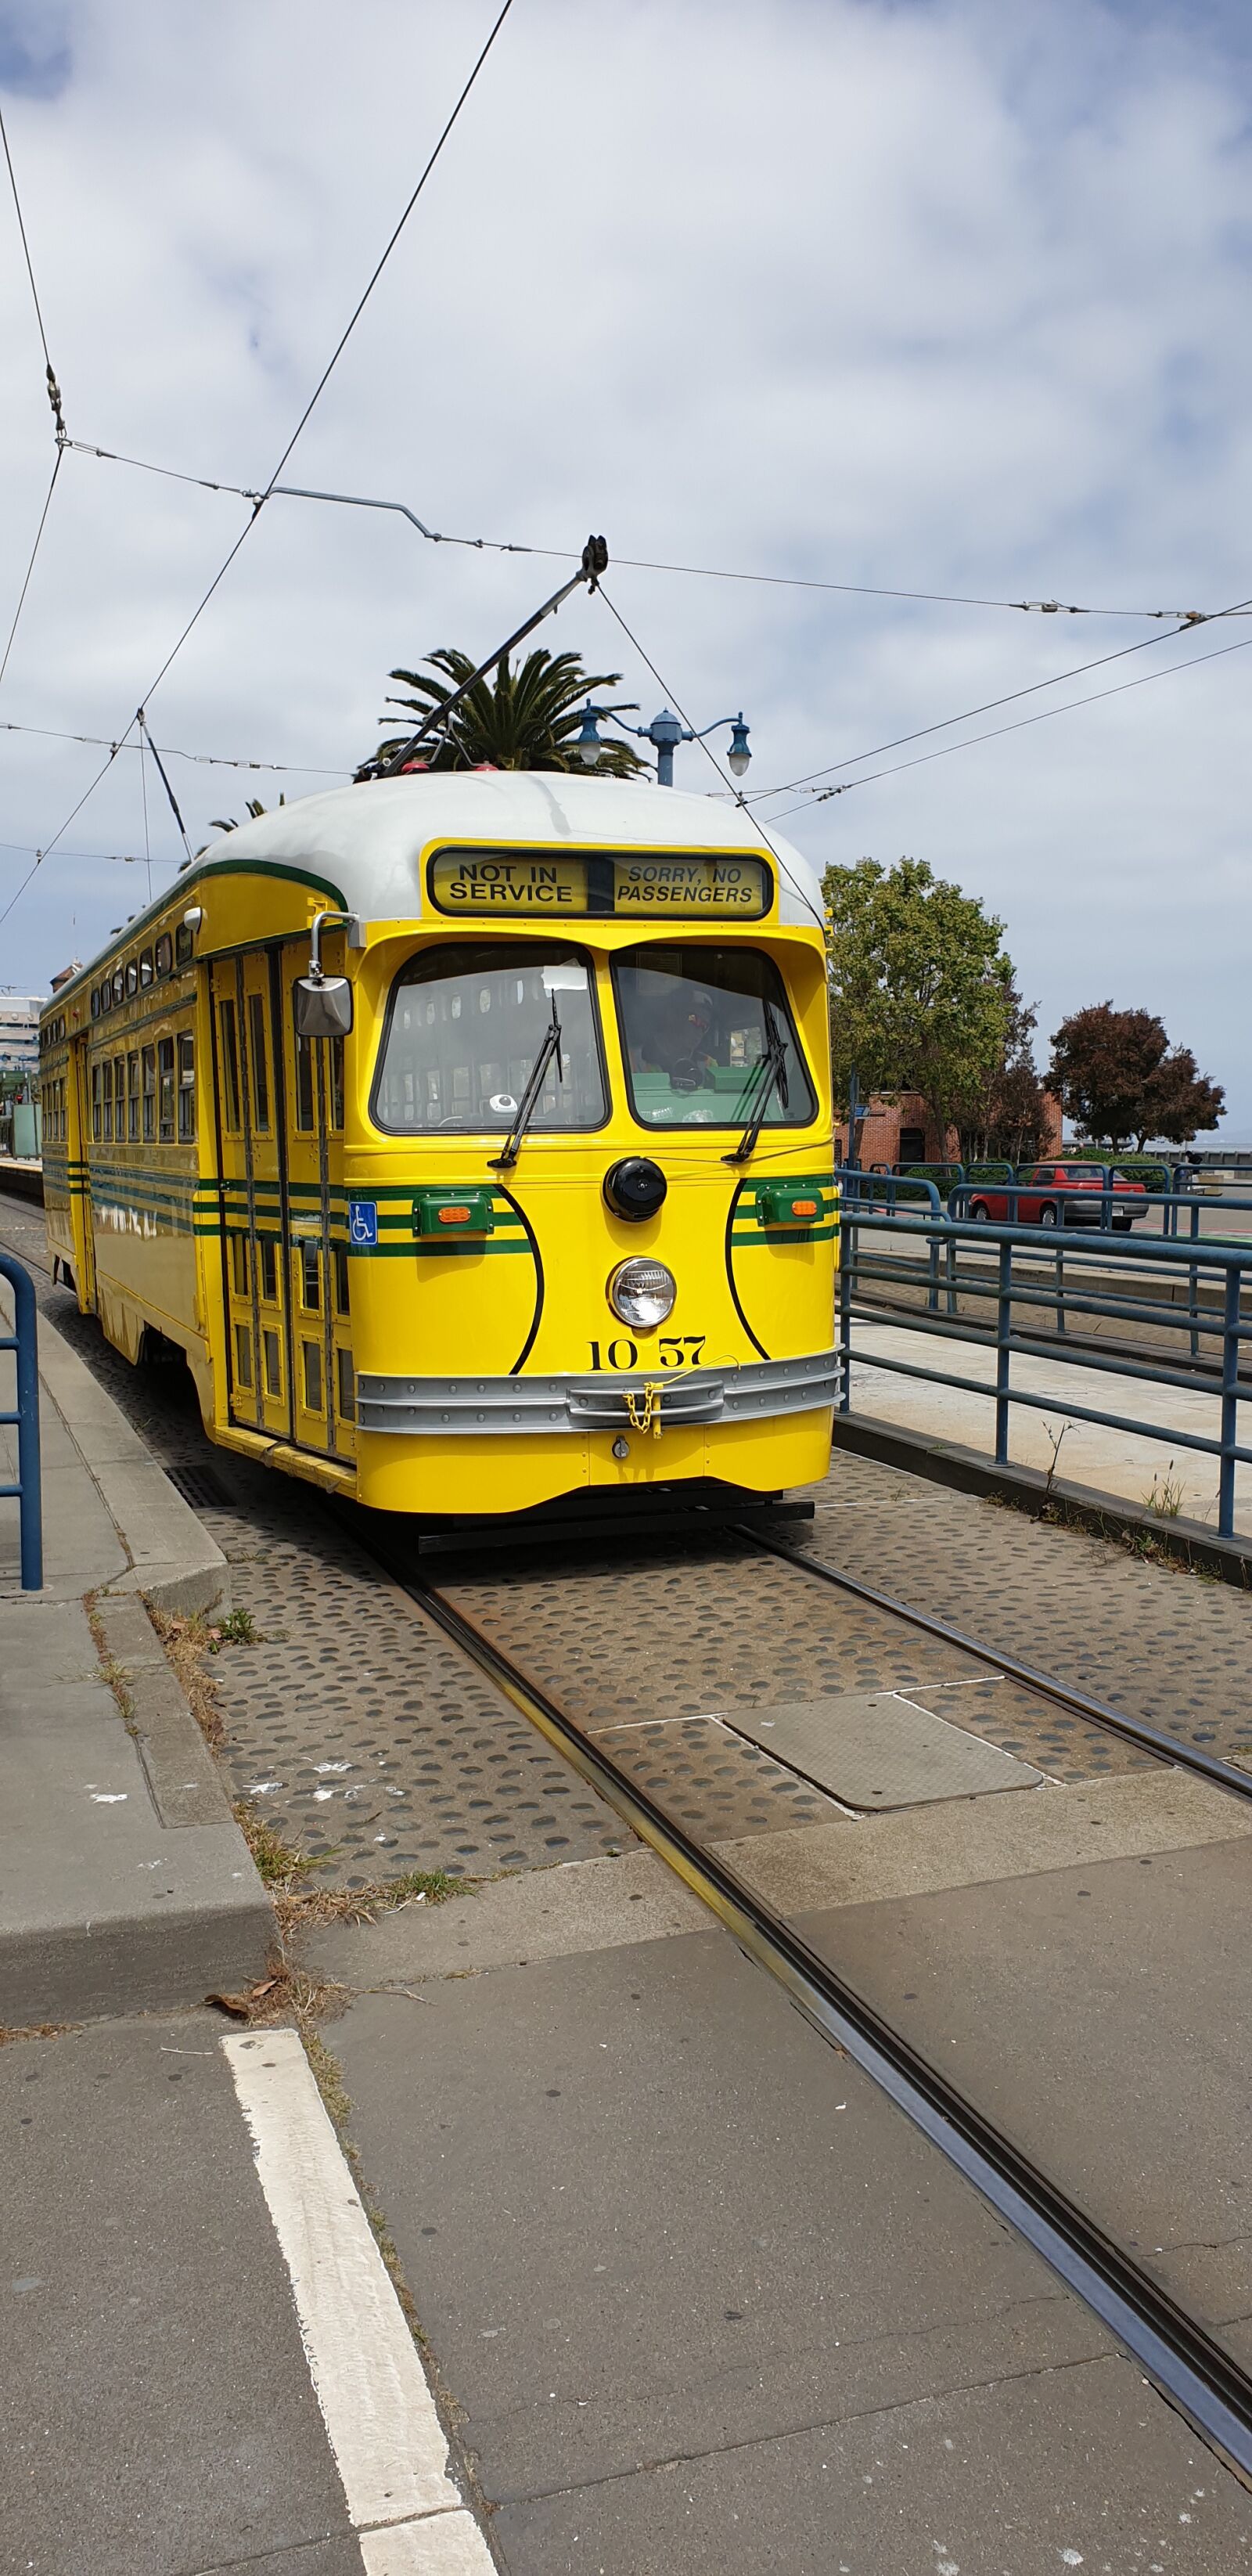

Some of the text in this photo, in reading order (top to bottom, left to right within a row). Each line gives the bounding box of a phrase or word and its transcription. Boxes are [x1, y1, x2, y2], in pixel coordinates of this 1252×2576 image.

[459, 863, 557, 884] NOT IN
[628, 866, 742, 886] SORRY, NO
[449, 882, 573, 903] SERVICE
[617, 885, 753, 903] PASSENGERS
